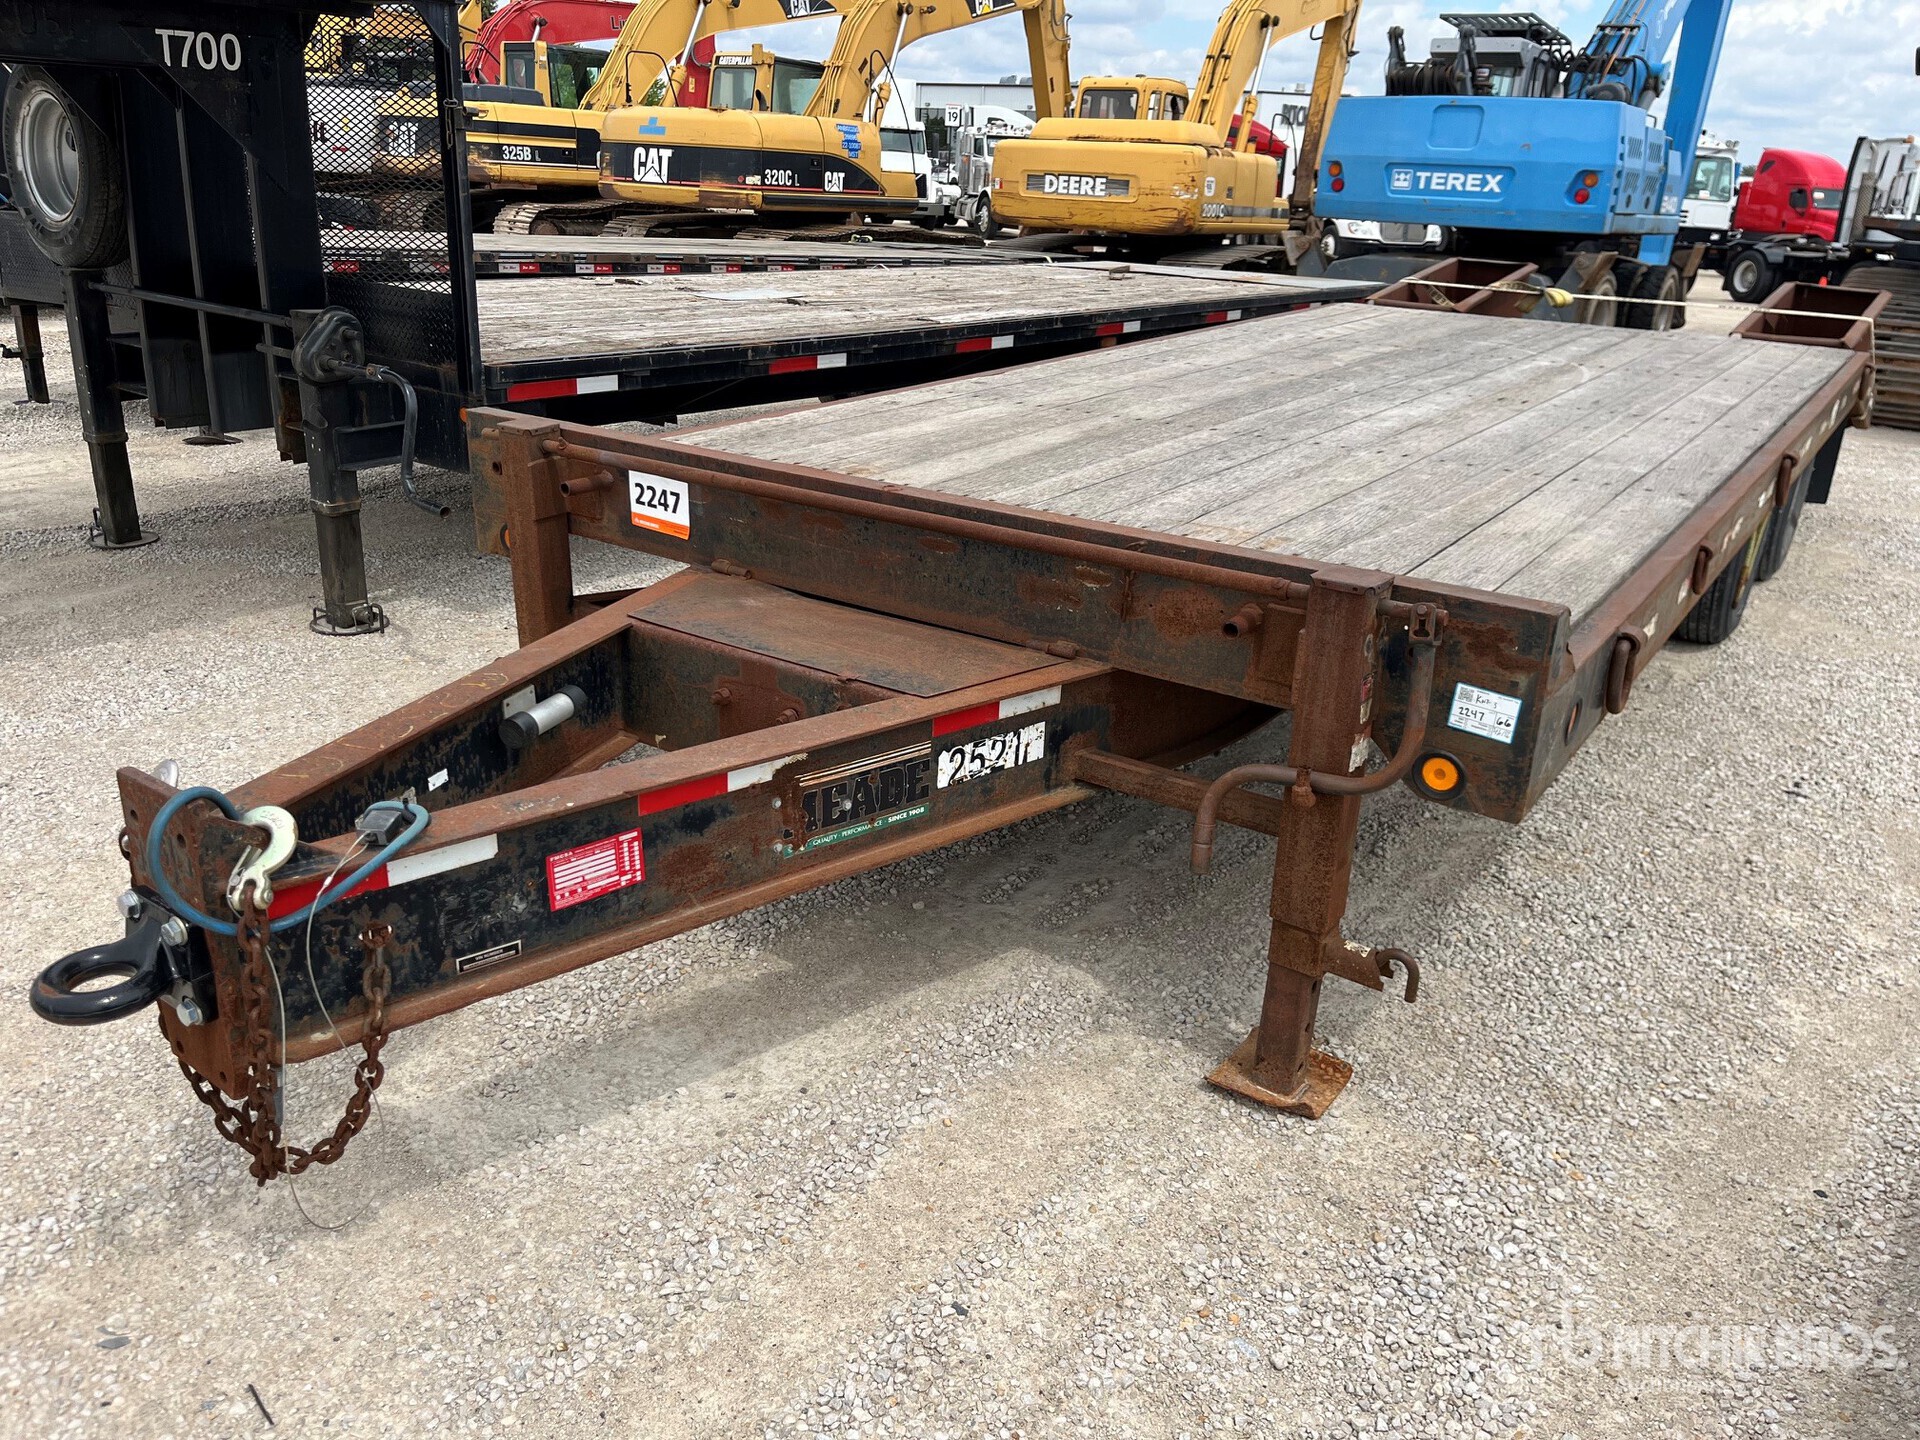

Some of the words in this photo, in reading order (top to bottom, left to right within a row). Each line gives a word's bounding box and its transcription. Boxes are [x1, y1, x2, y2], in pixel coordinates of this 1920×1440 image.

[154, 28, 242, 71] T700
[948, 111, 959, 122] 19
[502, 145, 532, 161] 325B
[534, 150, 541, 161] L
[633, 147, 673, 184] CAT
[764, 169, 792, 186] 320C
[794, 173, 800, 186] L
[824, 171, 845, 192] CAT
[1043, 173, 1107, 196] DEERE
[1416, 171, 1503, 193] TEREX
[634, 482, 680, 514] 2247
[1458, 706, 1485, 722] 2247
[1496, 716, 1512, 728] 66
[812, 833, 838, 847] QUALITY
[888, 813, 908, 824] SINCE
